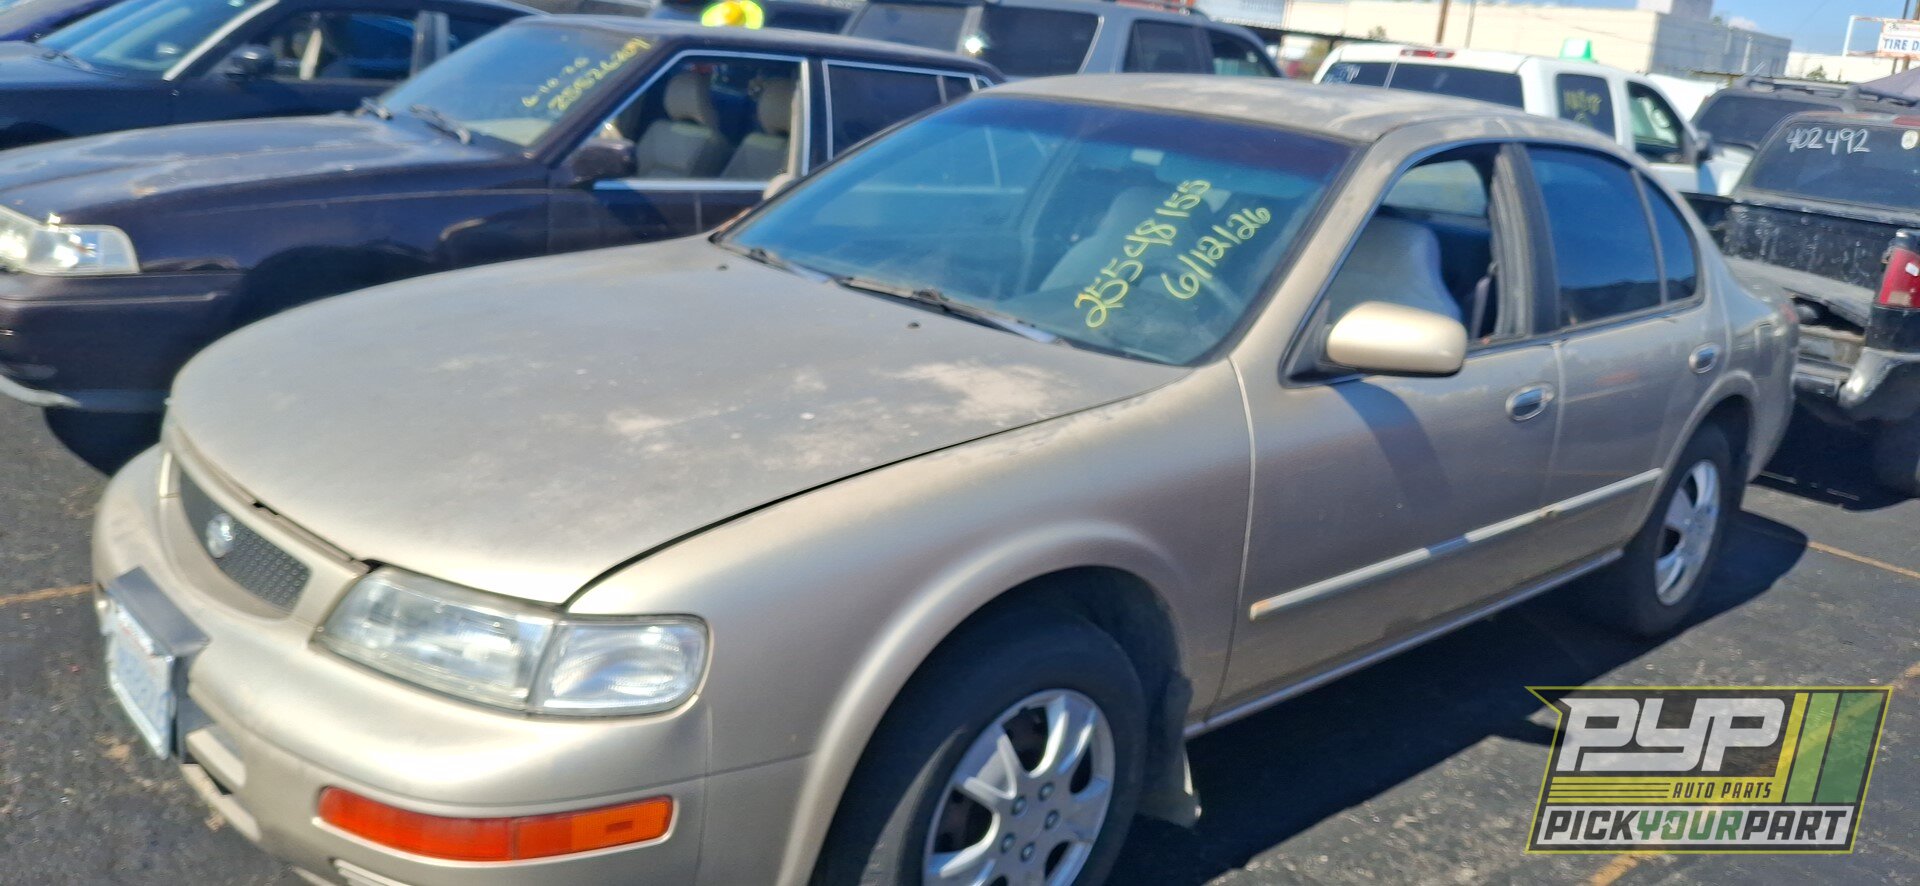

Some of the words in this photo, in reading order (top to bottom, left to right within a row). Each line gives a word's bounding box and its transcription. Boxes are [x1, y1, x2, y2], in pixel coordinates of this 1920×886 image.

[1884, 38, 1909, 51] TIRE
[1911, 40, 1920, 51] D
[1161, 207, 1271, 300] 6/12/26
